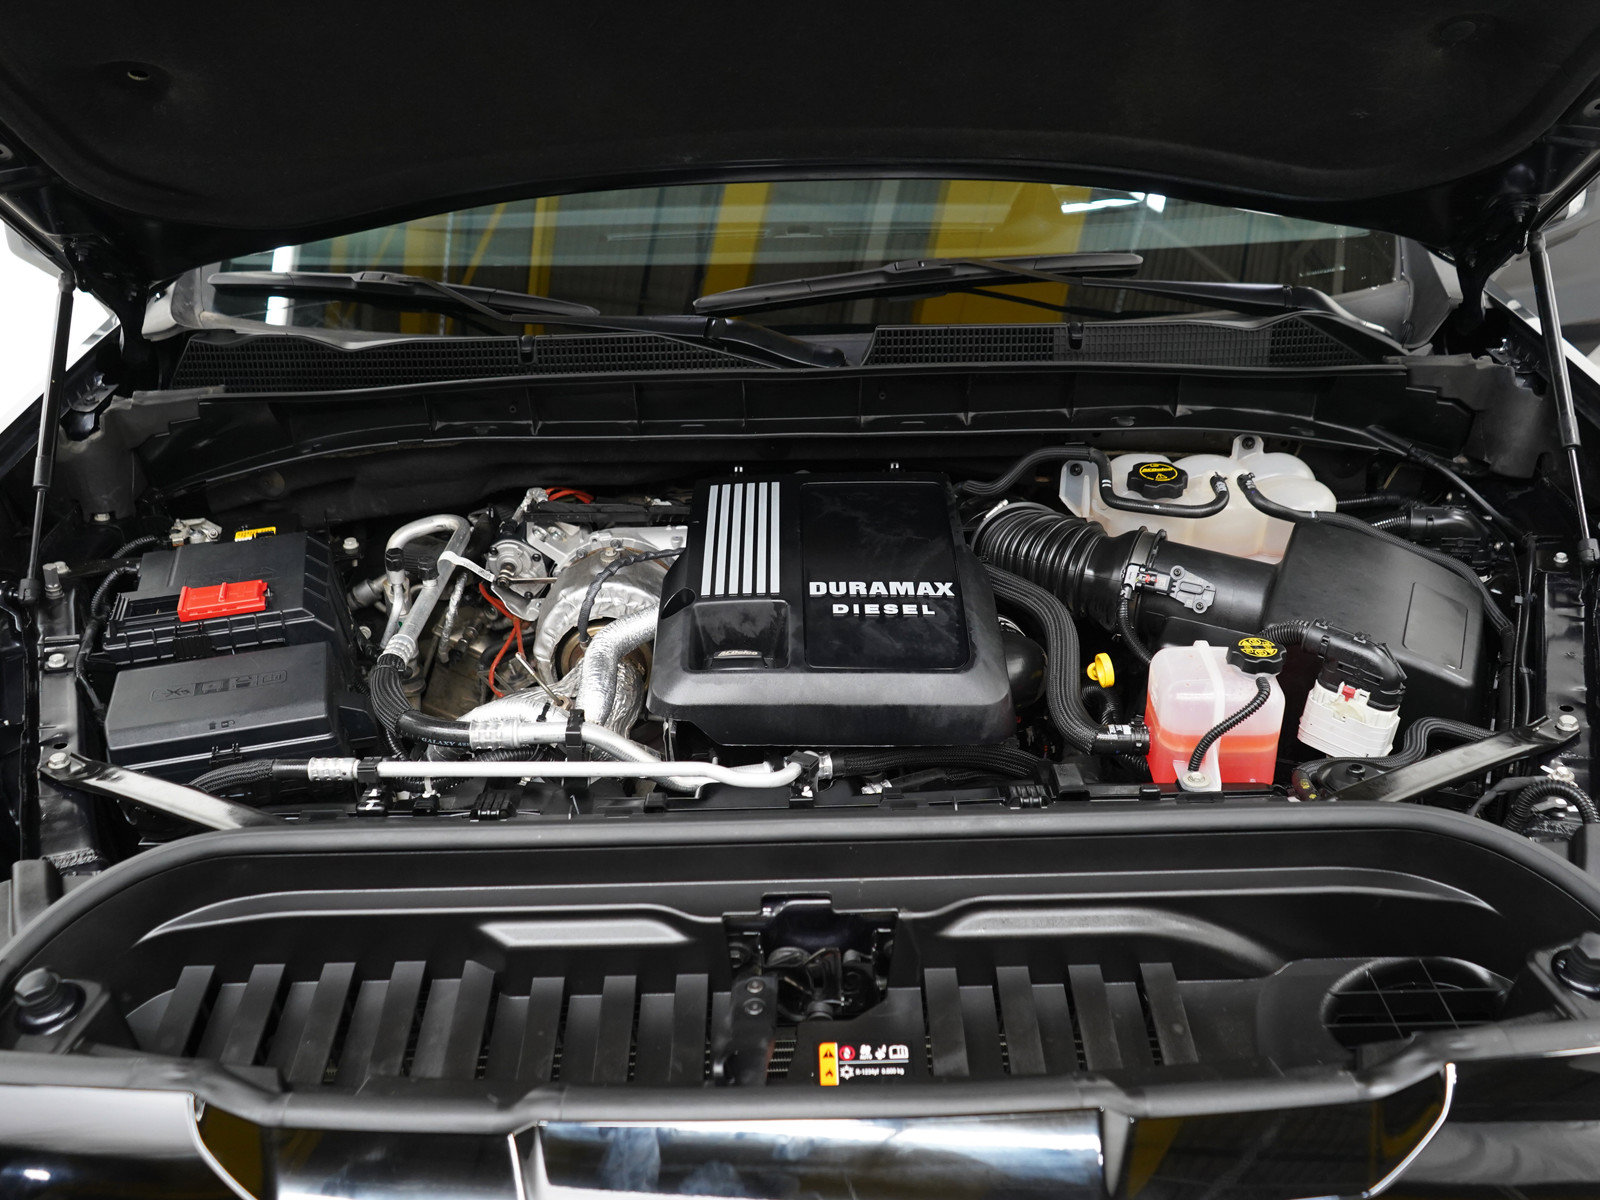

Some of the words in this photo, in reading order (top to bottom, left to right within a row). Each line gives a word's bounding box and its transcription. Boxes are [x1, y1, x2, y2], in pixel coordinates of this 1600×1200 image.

[809, 581, 956, 598] DURAMAX
[832, 603, 936, 617] DIESEL
[421, 737, 456, 746] GALAXY
